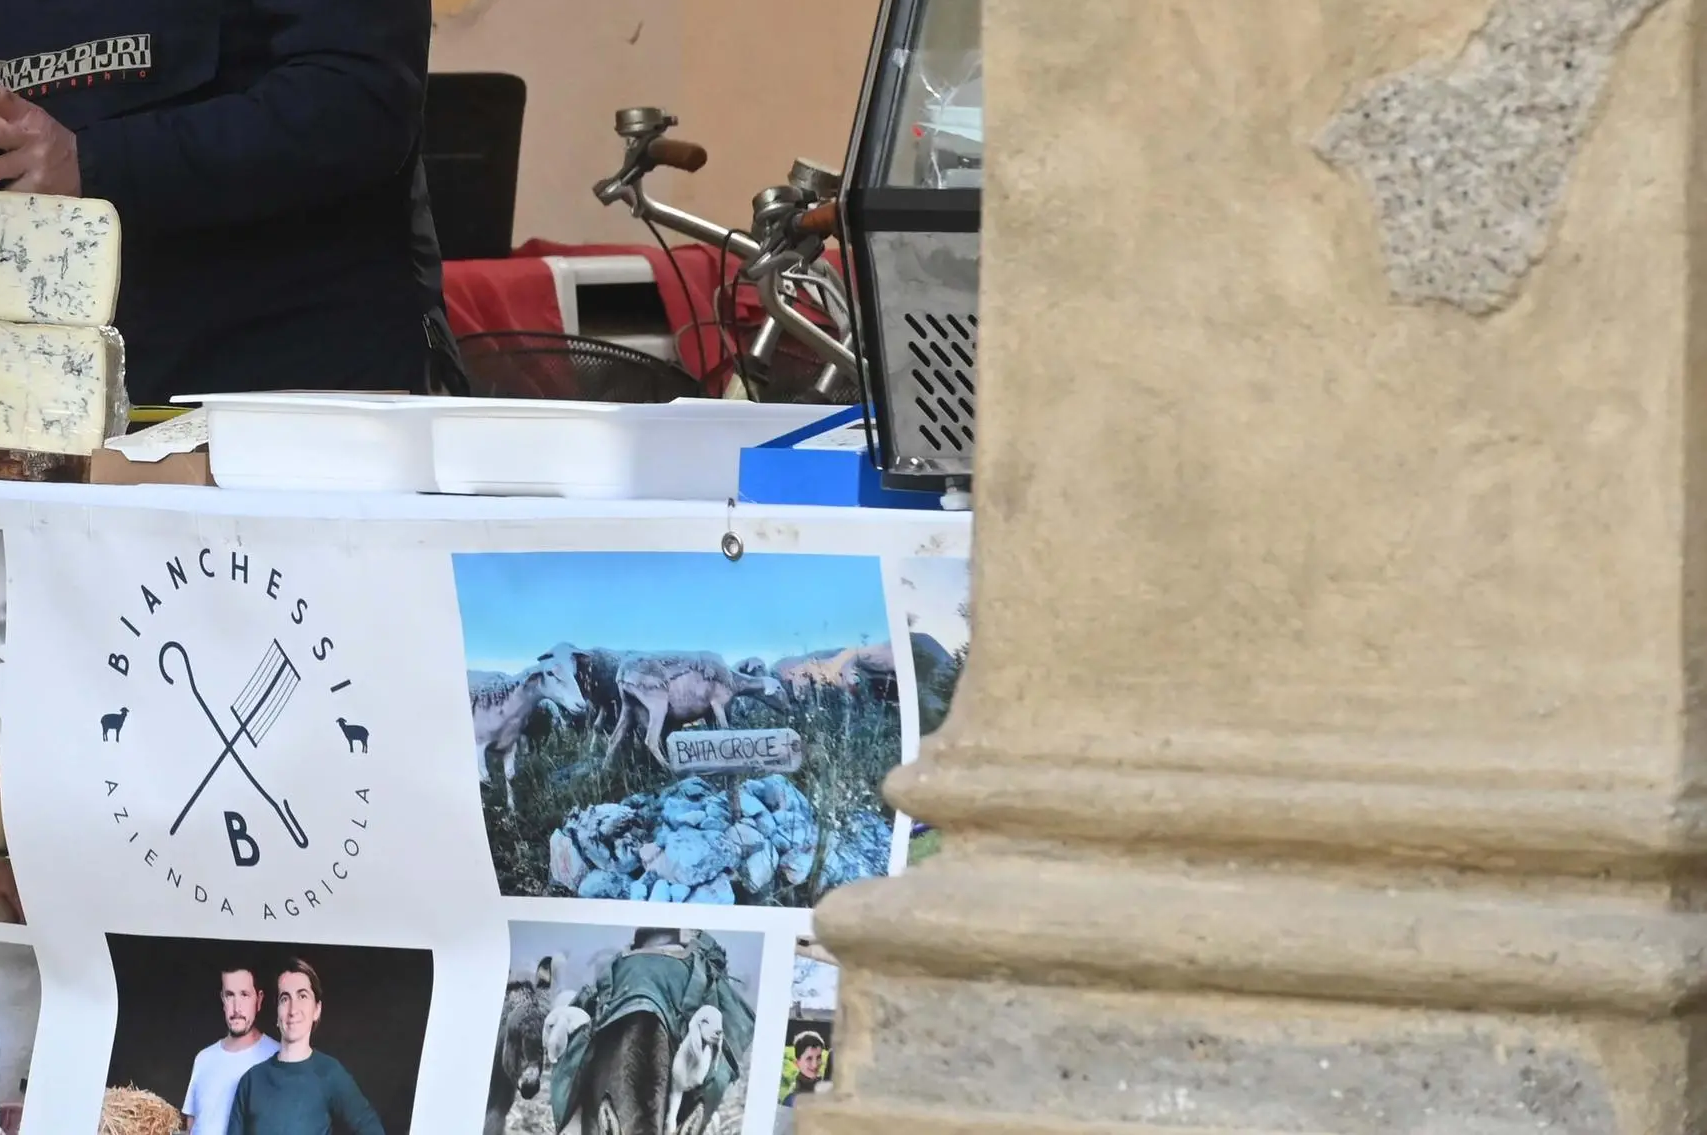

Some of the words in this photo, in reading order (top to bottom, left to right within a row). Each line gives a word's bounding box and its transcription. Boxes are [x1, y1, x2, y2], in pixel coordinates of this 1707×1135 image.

[0, 34, 150, 92] NAPAPIJRI
[108, 548, 352, 694] BIANCHESSI
[676, 740, 718, 765] BAITA
[720, 737, 779, 760] CROCE
[104, 779, 235, 916] AZIENDA
[263, 787, 371, 921] AGRICOLA
[223, 810, 261, 867] B
